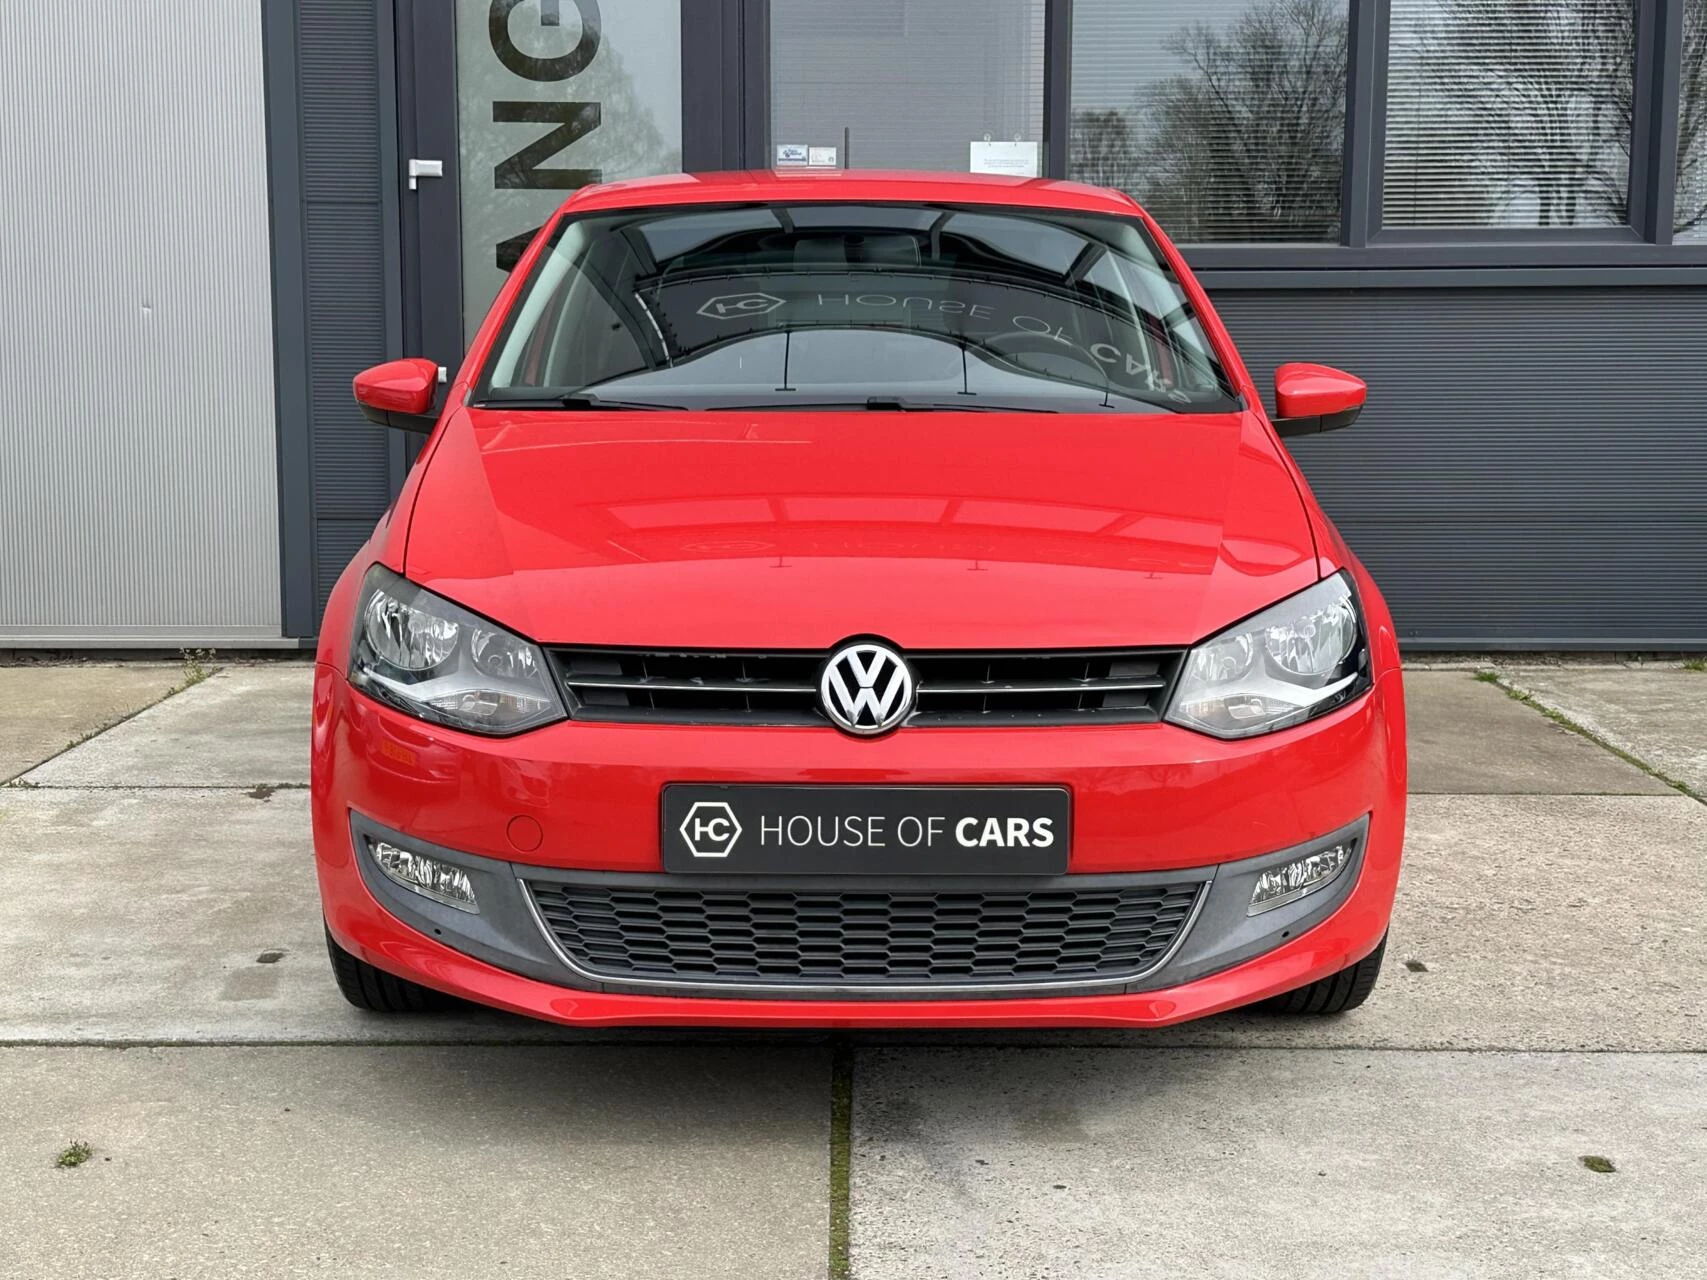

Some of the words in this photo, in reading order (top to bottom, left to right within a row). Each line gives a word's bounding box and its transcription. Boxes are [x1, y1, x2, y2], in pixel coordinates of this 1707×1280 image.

[760, 815, 886, 847] HOUSE
[897, 815, 946, 847] OF
[955, 817, 1055, 848] CARS
